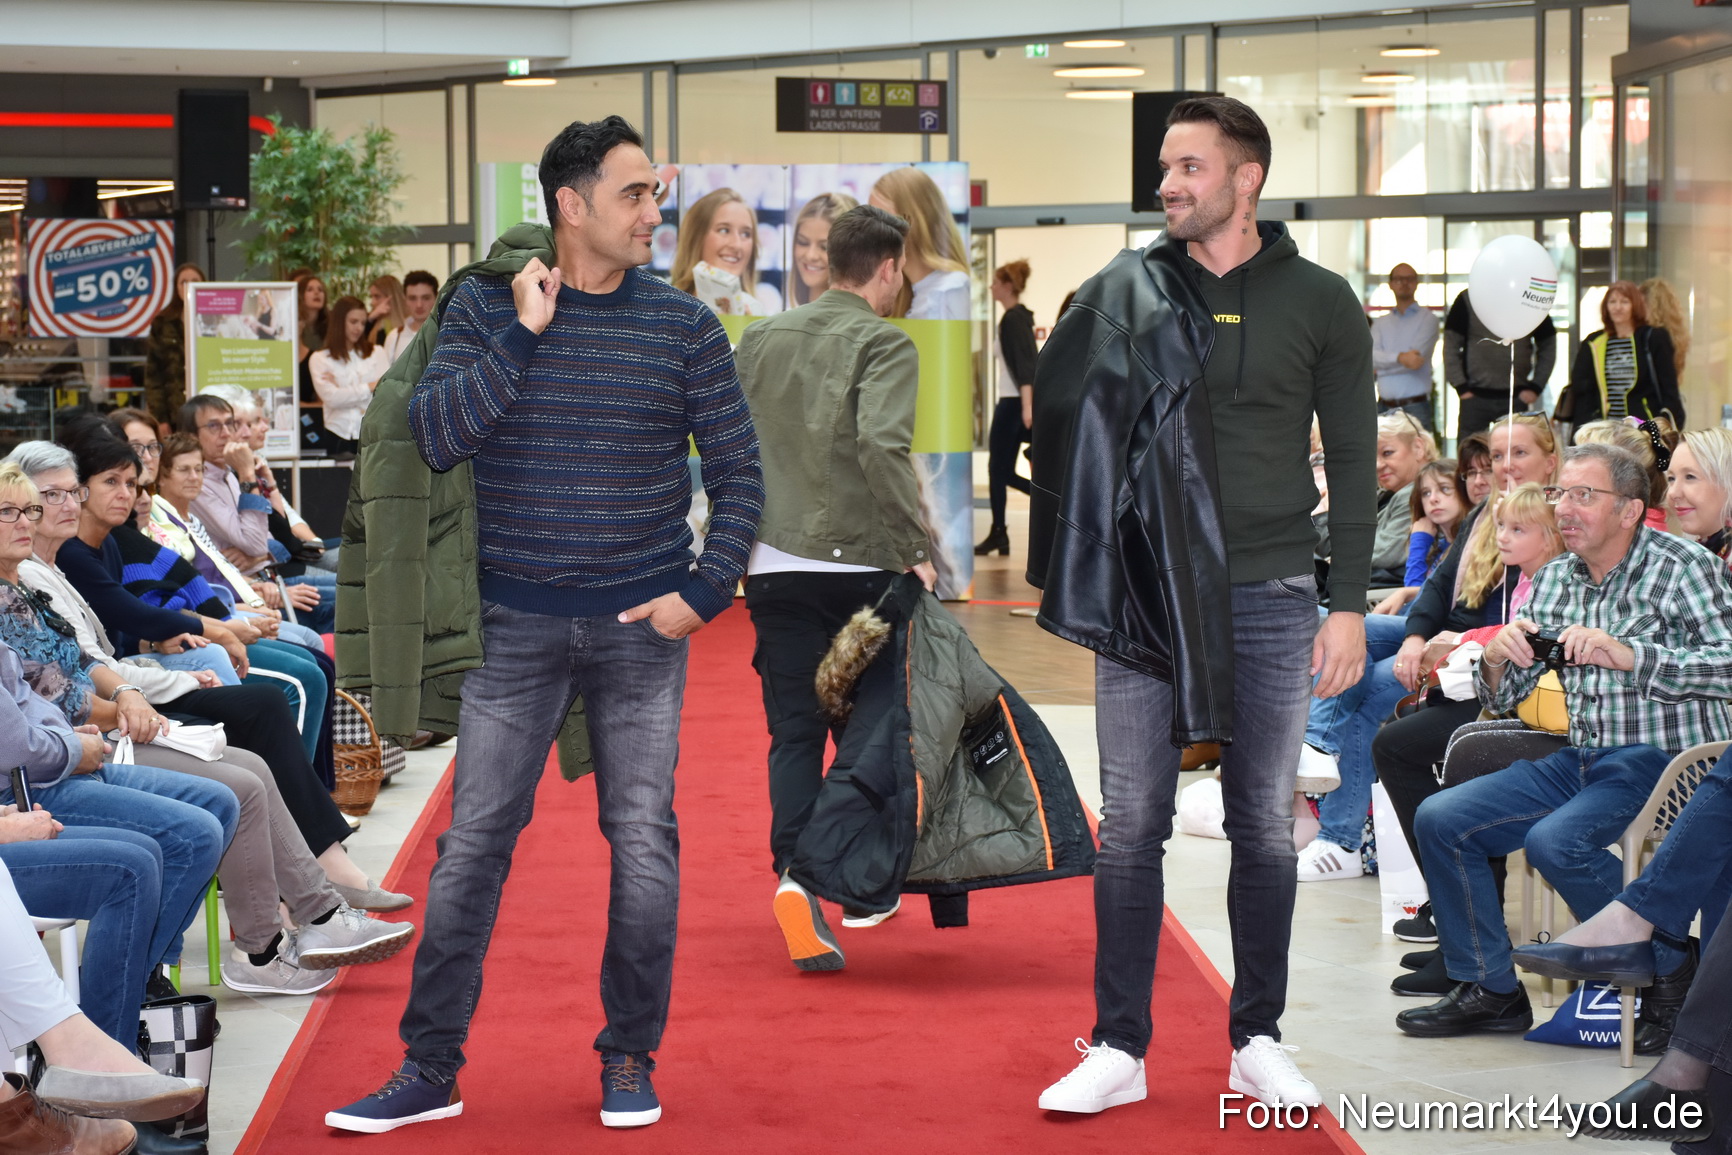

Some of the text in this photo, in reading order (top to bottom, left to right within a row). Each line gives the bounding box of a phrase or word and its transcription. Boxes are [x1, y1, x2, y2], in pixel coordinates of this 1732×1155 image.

[809, 109, 882, 119] IN DER UNTEREN
[809, 121, 882, 131] LADENSTRASSE
[47, 233, 152, 264] TOTALABVERKAUF
[54, 263, 150, 303] -50%
